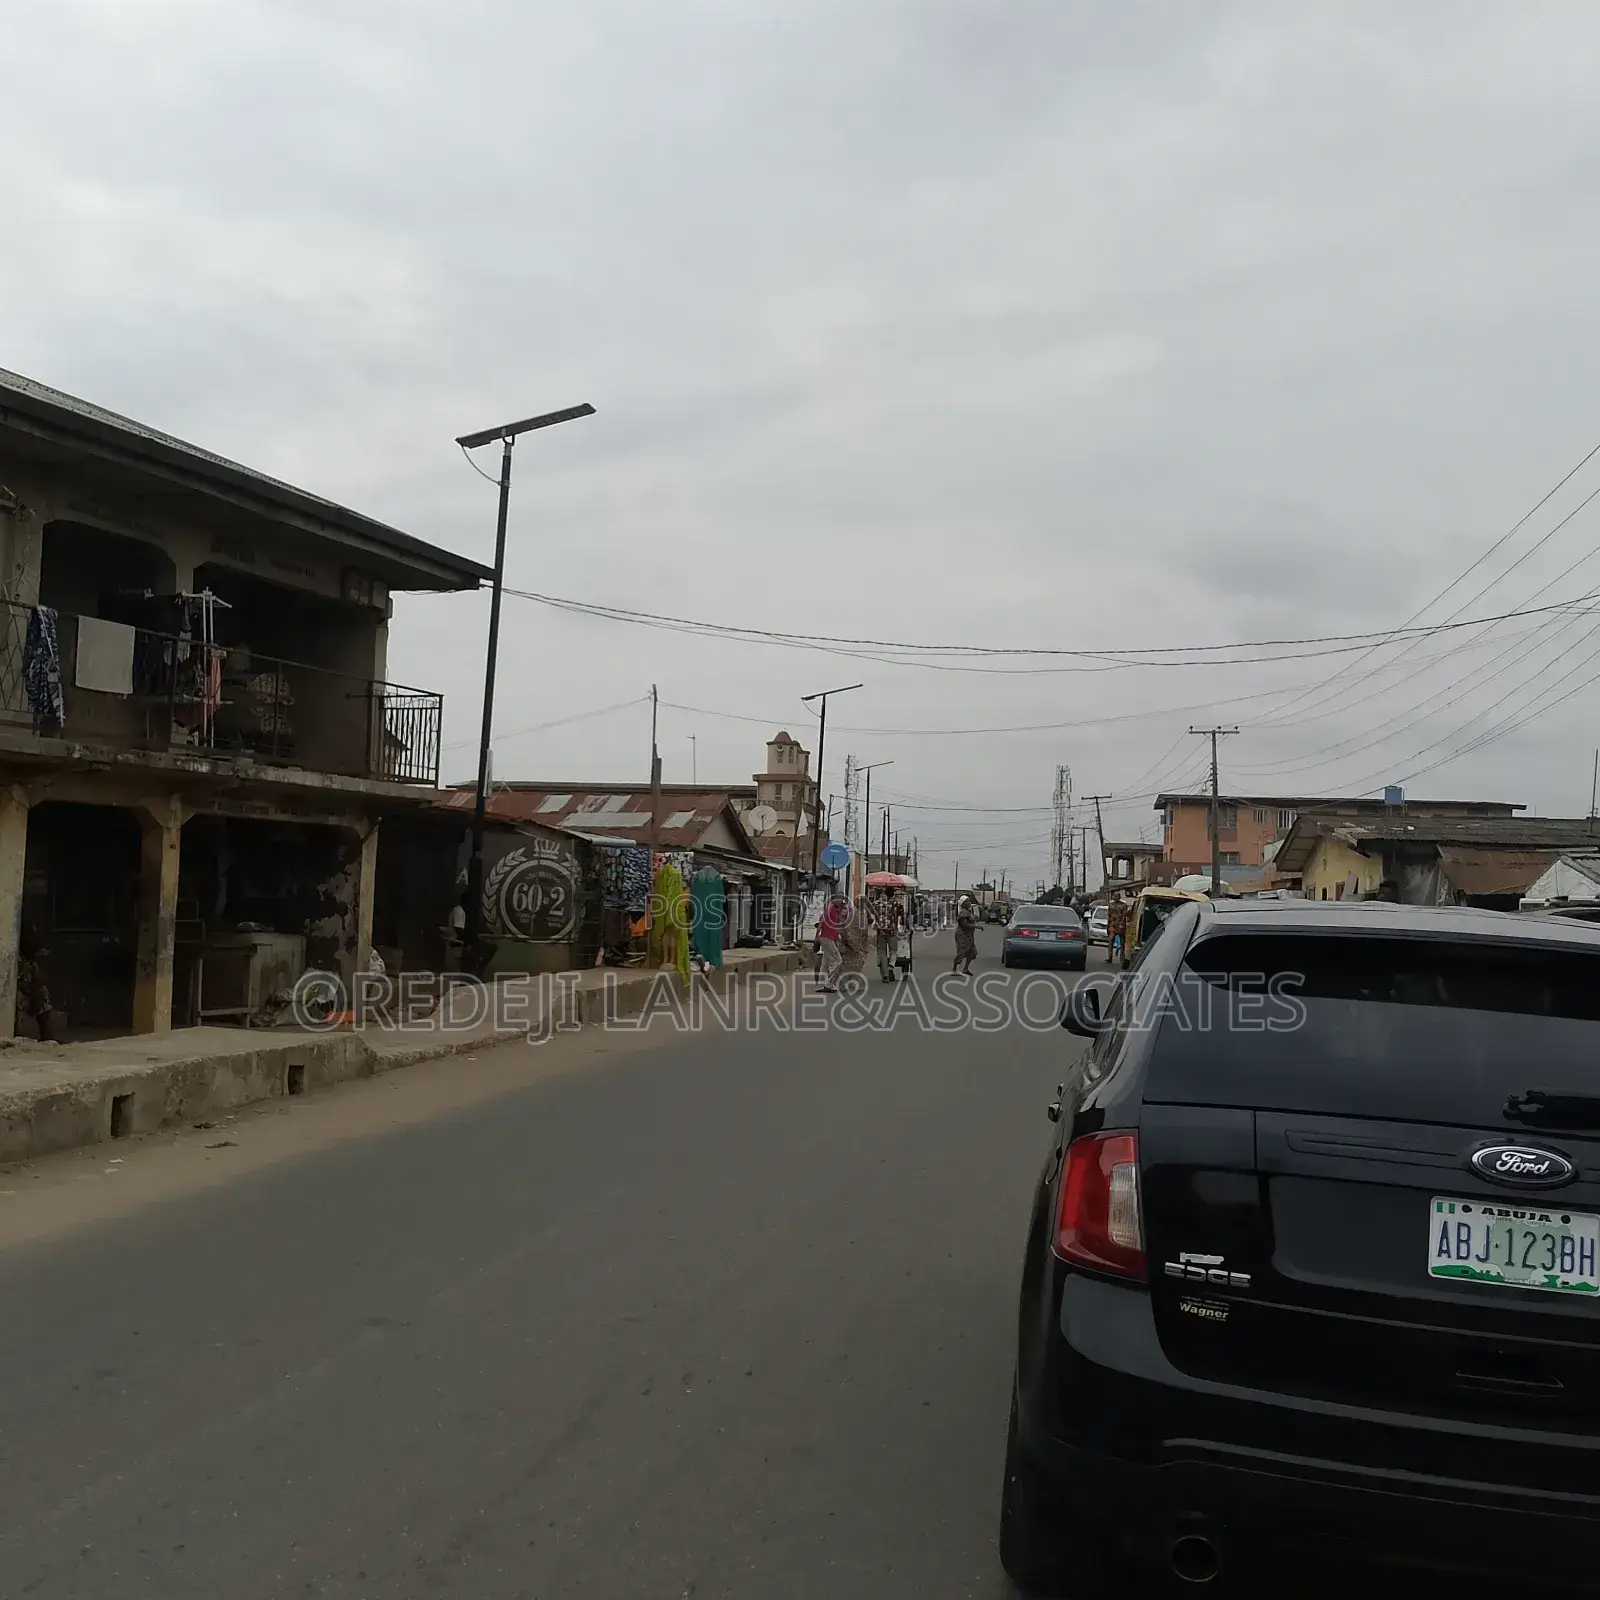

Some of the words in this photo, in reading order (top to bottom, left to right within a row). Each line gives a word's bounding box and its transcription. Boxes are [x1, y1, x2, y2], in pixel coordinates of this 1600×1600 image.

[1495, 1151, 1551, 1175] Ford
[1481, 1207, 1552, 1223] ABUJA
[1179, 1302, 1230, 1319] Wagner
